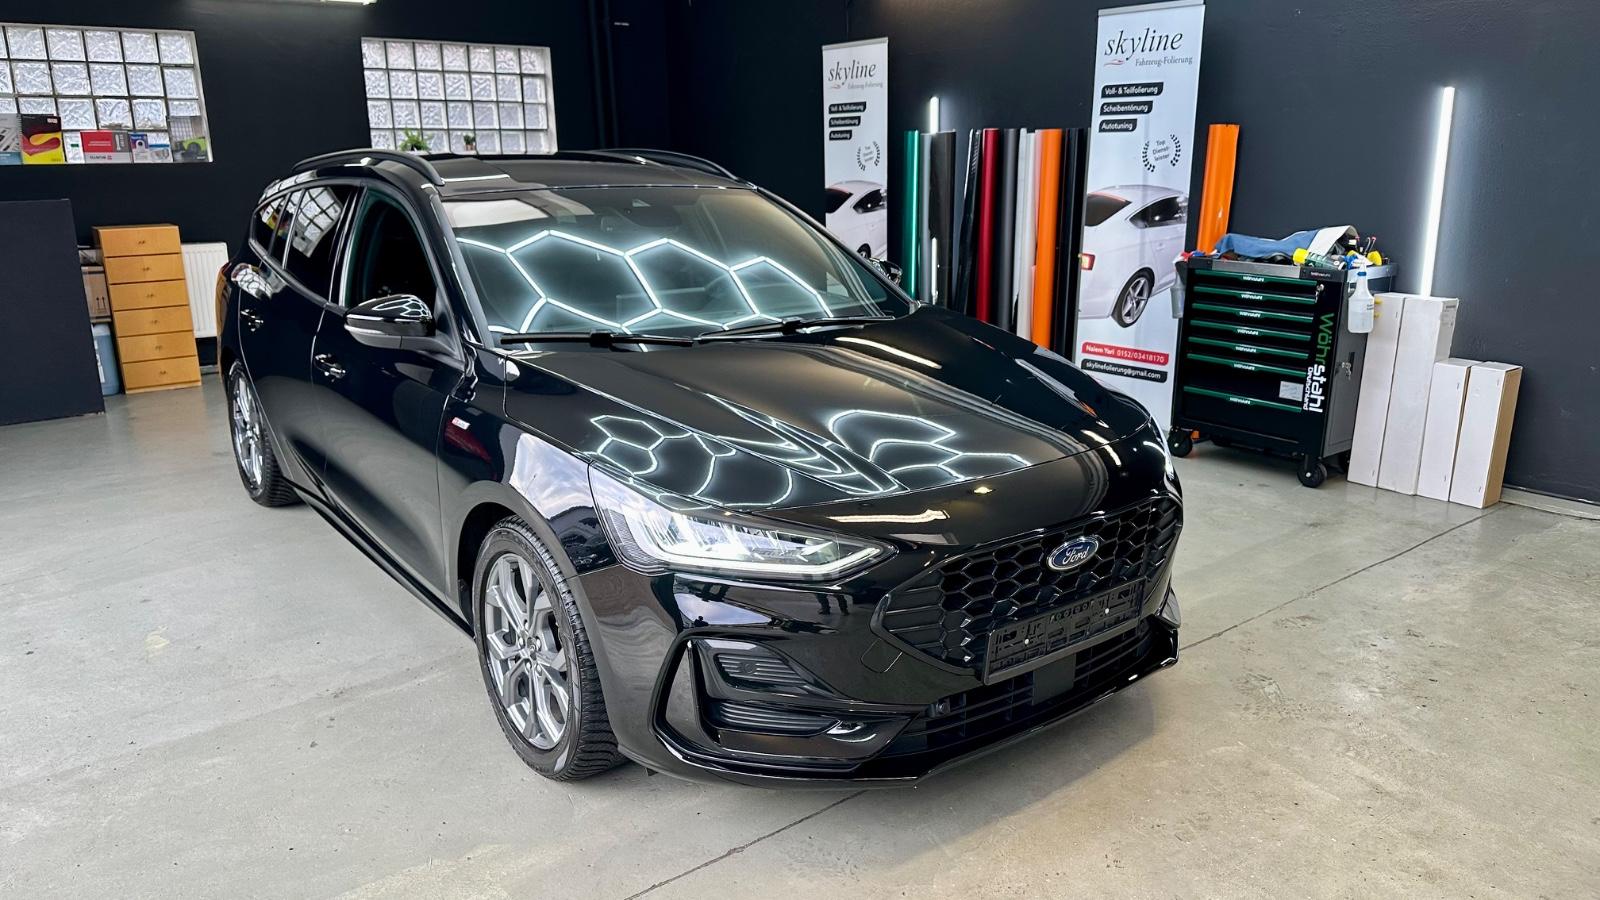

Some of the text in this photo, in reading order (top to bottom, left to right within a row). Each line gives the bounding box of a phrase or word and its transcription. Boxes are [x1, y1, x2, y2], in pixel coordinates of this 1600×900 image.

[1104, 27, 1183, 61] skyline
[1135, 55, 1193, 67] Fahrzeug-Folierung
[828, 59, 877, 86] skyline
[1123, 85, 1158, 95] Teilfolierung
[1103, 104, 1149, 112] Scheibentönung
[1101, 122, 1133, 130] Autotuning
[1086, 344, 1103, 353] Naiem
[1116, 349, 1165, 363] 0152/03418170
[1086, 361, 1161, 379] skylinefolierung@gmail.com
[1062, 545, 1090, 565] Ford
